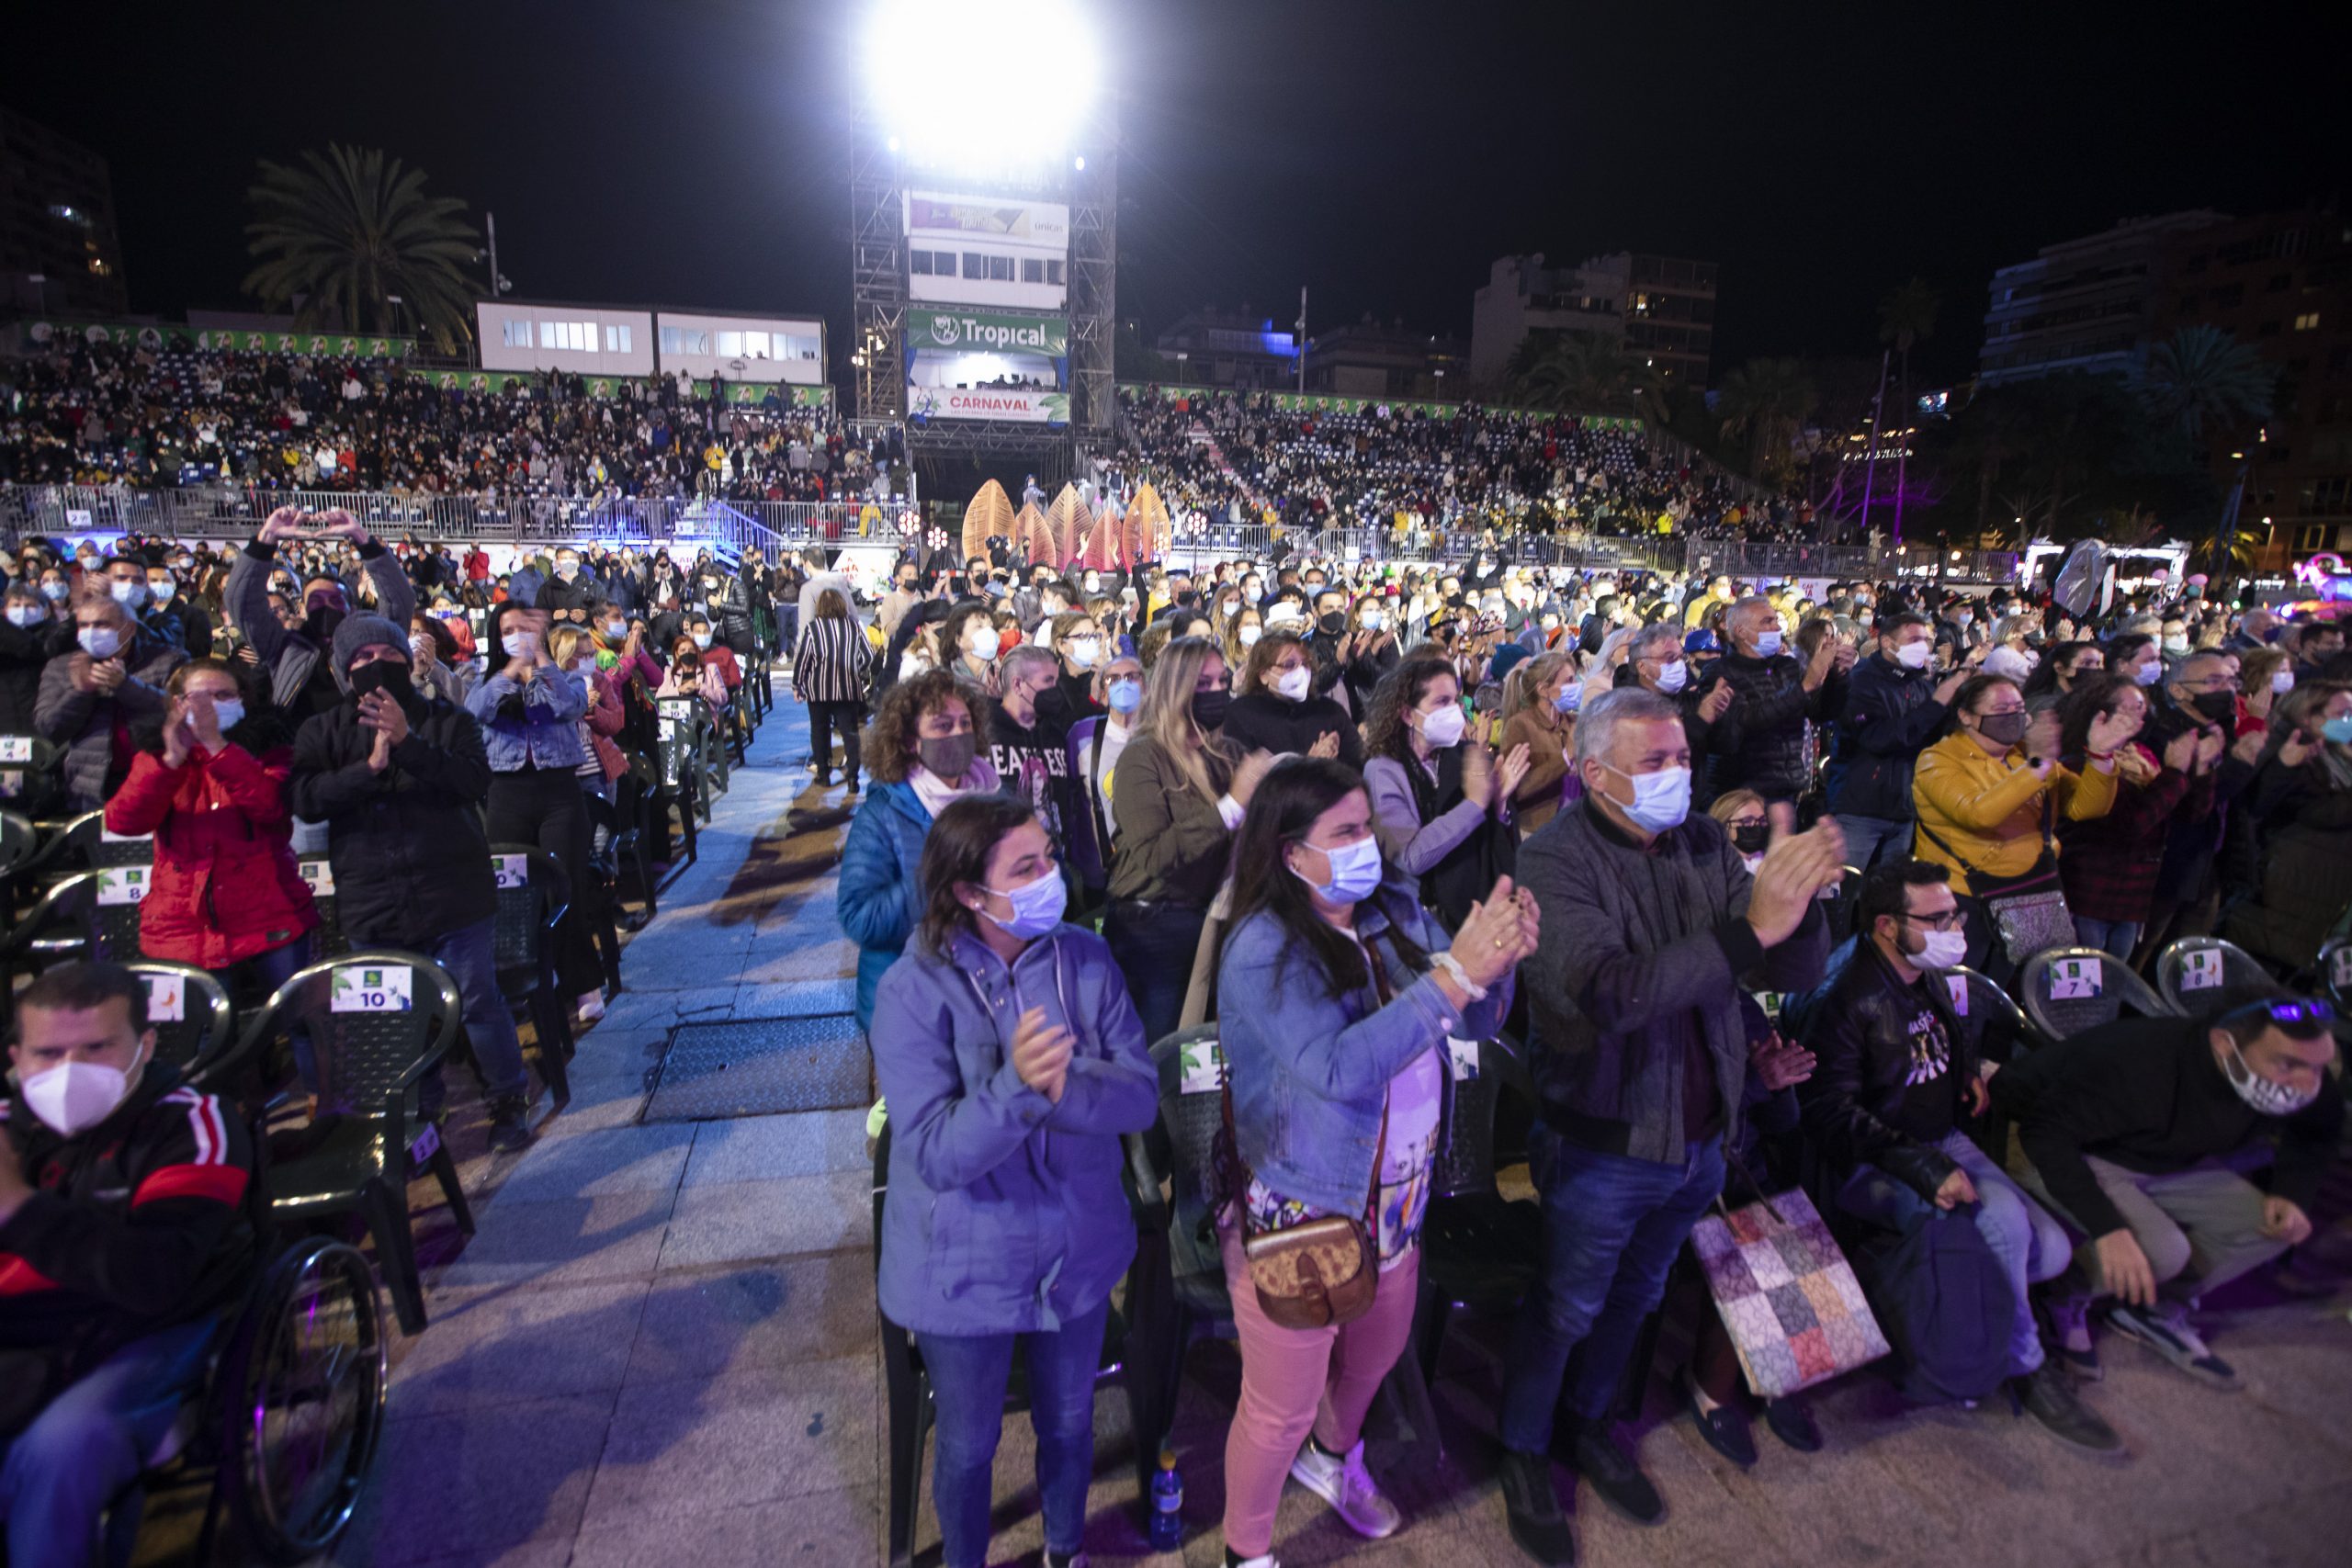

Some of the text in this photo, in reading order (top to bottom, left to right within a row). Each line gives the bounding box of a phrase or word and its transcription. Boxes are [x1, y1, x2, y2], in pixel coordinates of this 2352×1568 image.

[962, 319, 1046, 348] Tropical
[950, 396, 1031, 411] CARNAVAL
[130, 887, 141, 899] 8
[2069, 981, 2078, 996] 7
[360, 992, 386, 1008] 10
